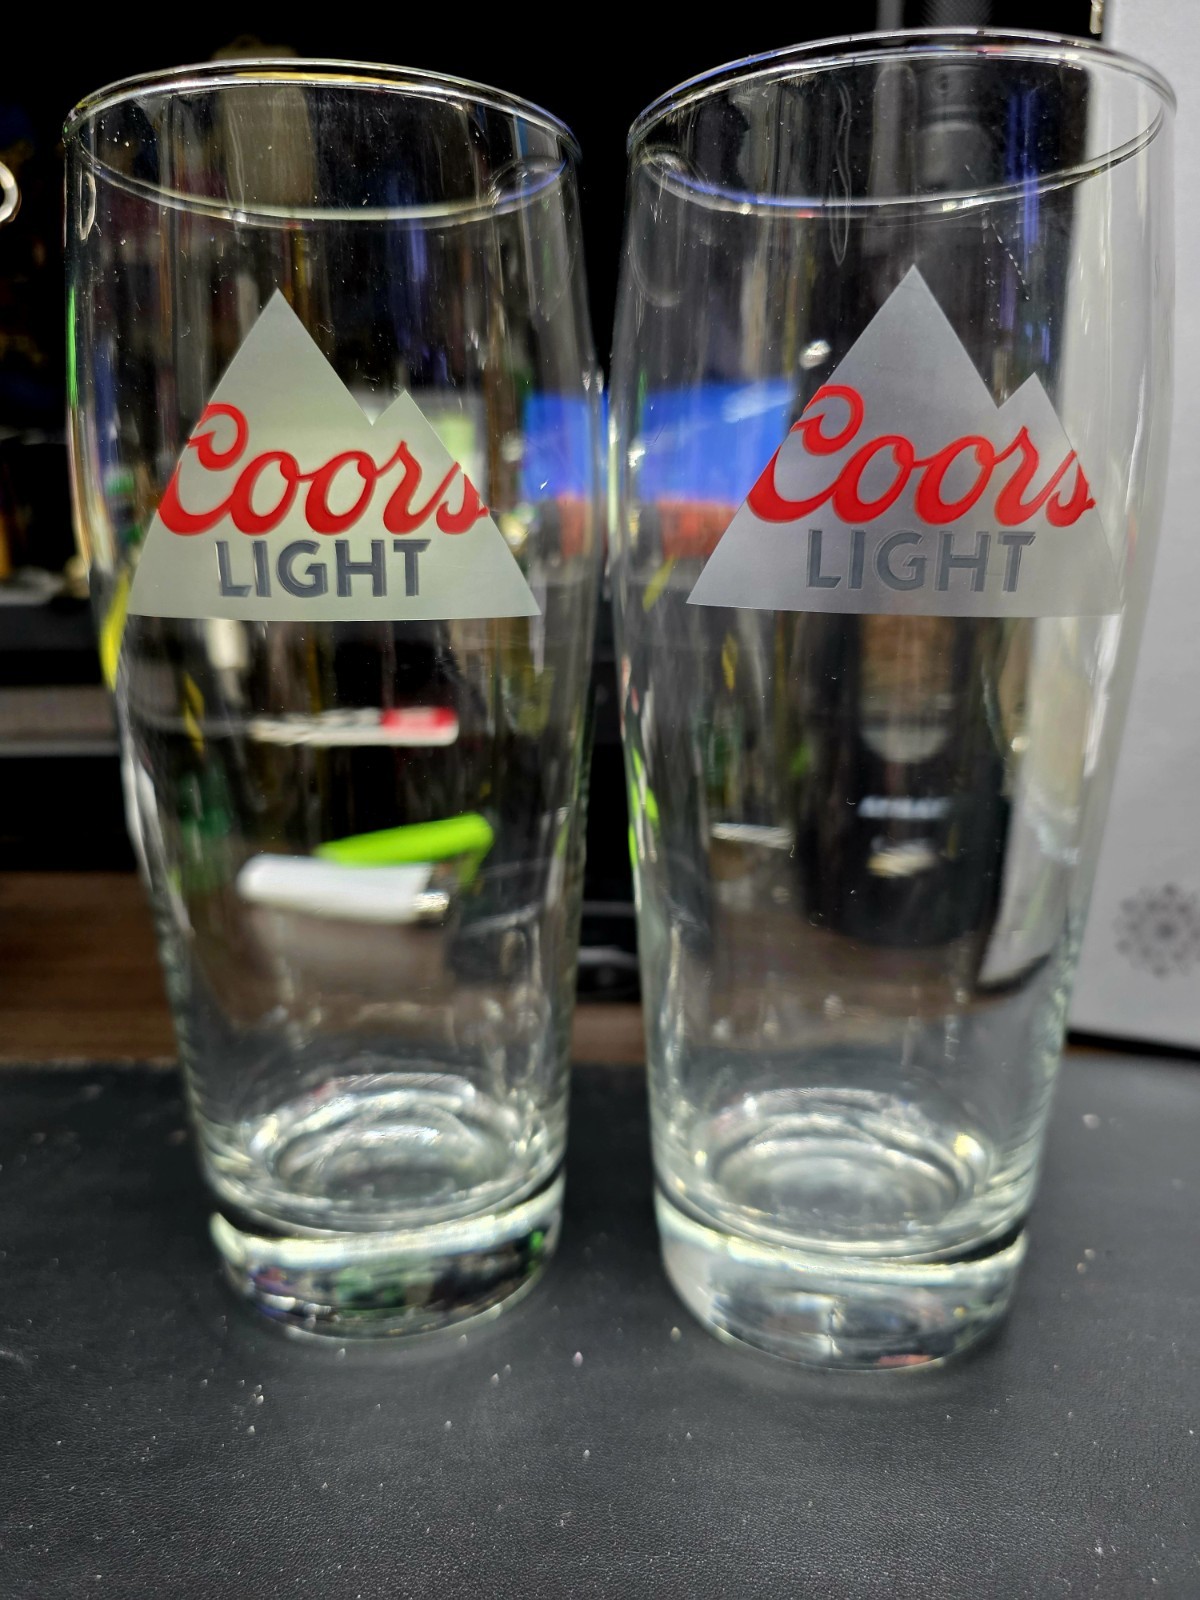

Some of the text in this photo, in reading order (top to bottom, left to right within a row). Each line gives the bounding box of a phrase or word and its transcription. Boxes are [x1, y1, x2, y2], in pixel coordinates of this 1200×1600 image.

[157, 403, 489, 536] Coors
[747, 384, 1096, 527] Coors
[214, 538, 431, 598] LIGHT
[806, 528, 1036, 593] LIGHT
